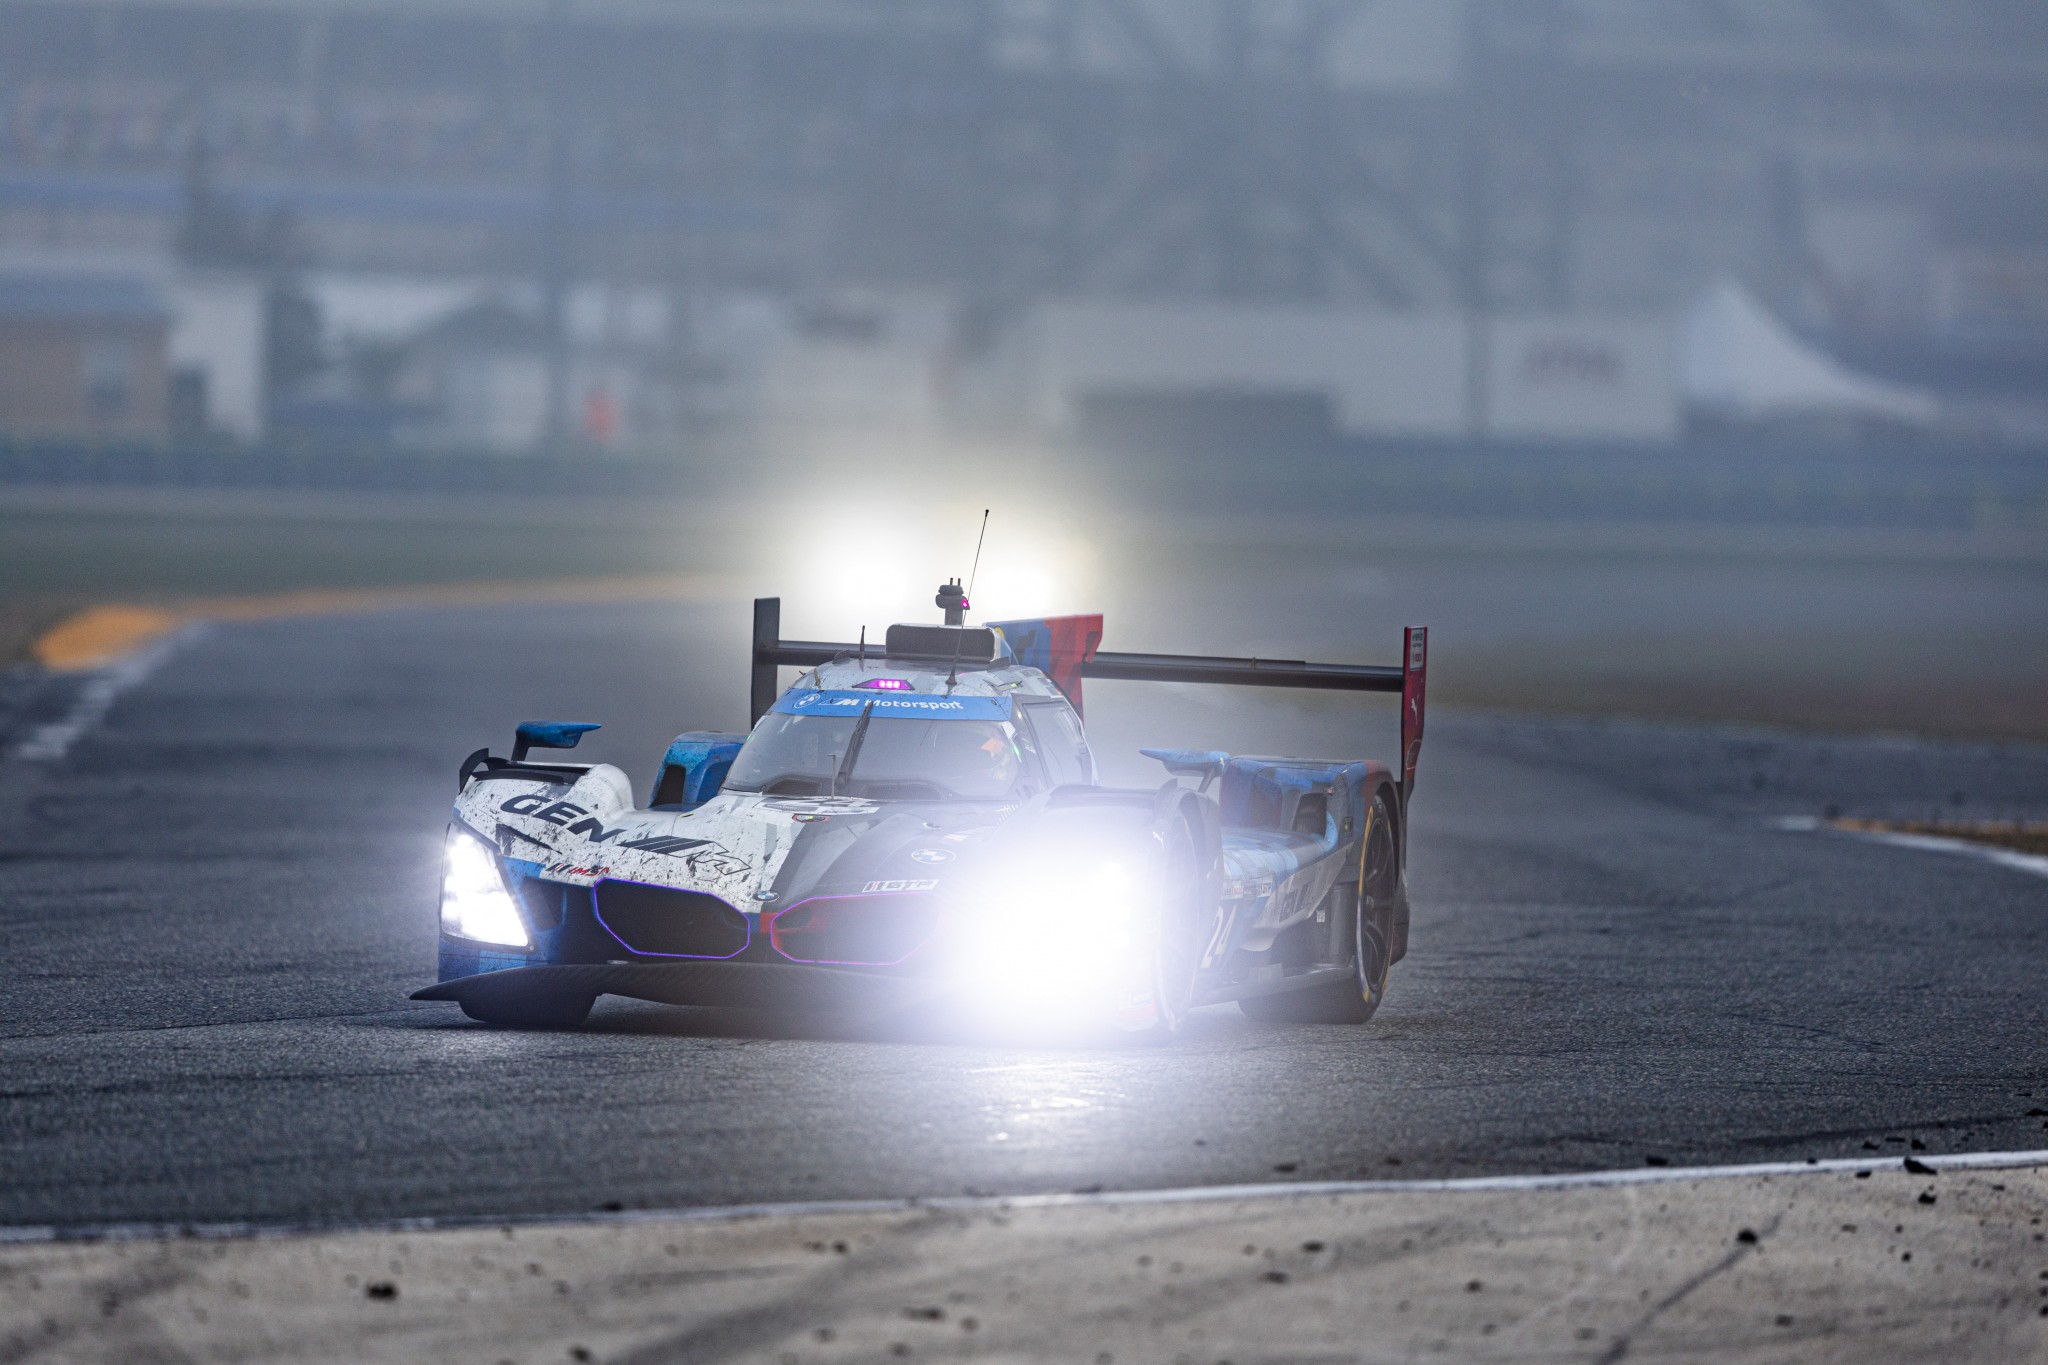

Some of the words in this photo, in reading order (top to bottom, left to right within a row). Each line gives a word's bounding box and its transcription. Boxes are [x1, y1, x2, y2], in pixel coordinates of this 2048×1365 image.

[864, 699, 964, 711] Motorsport
[500, 794, 628, 843] GEN
[1200, 905, 1238, 969] 24
